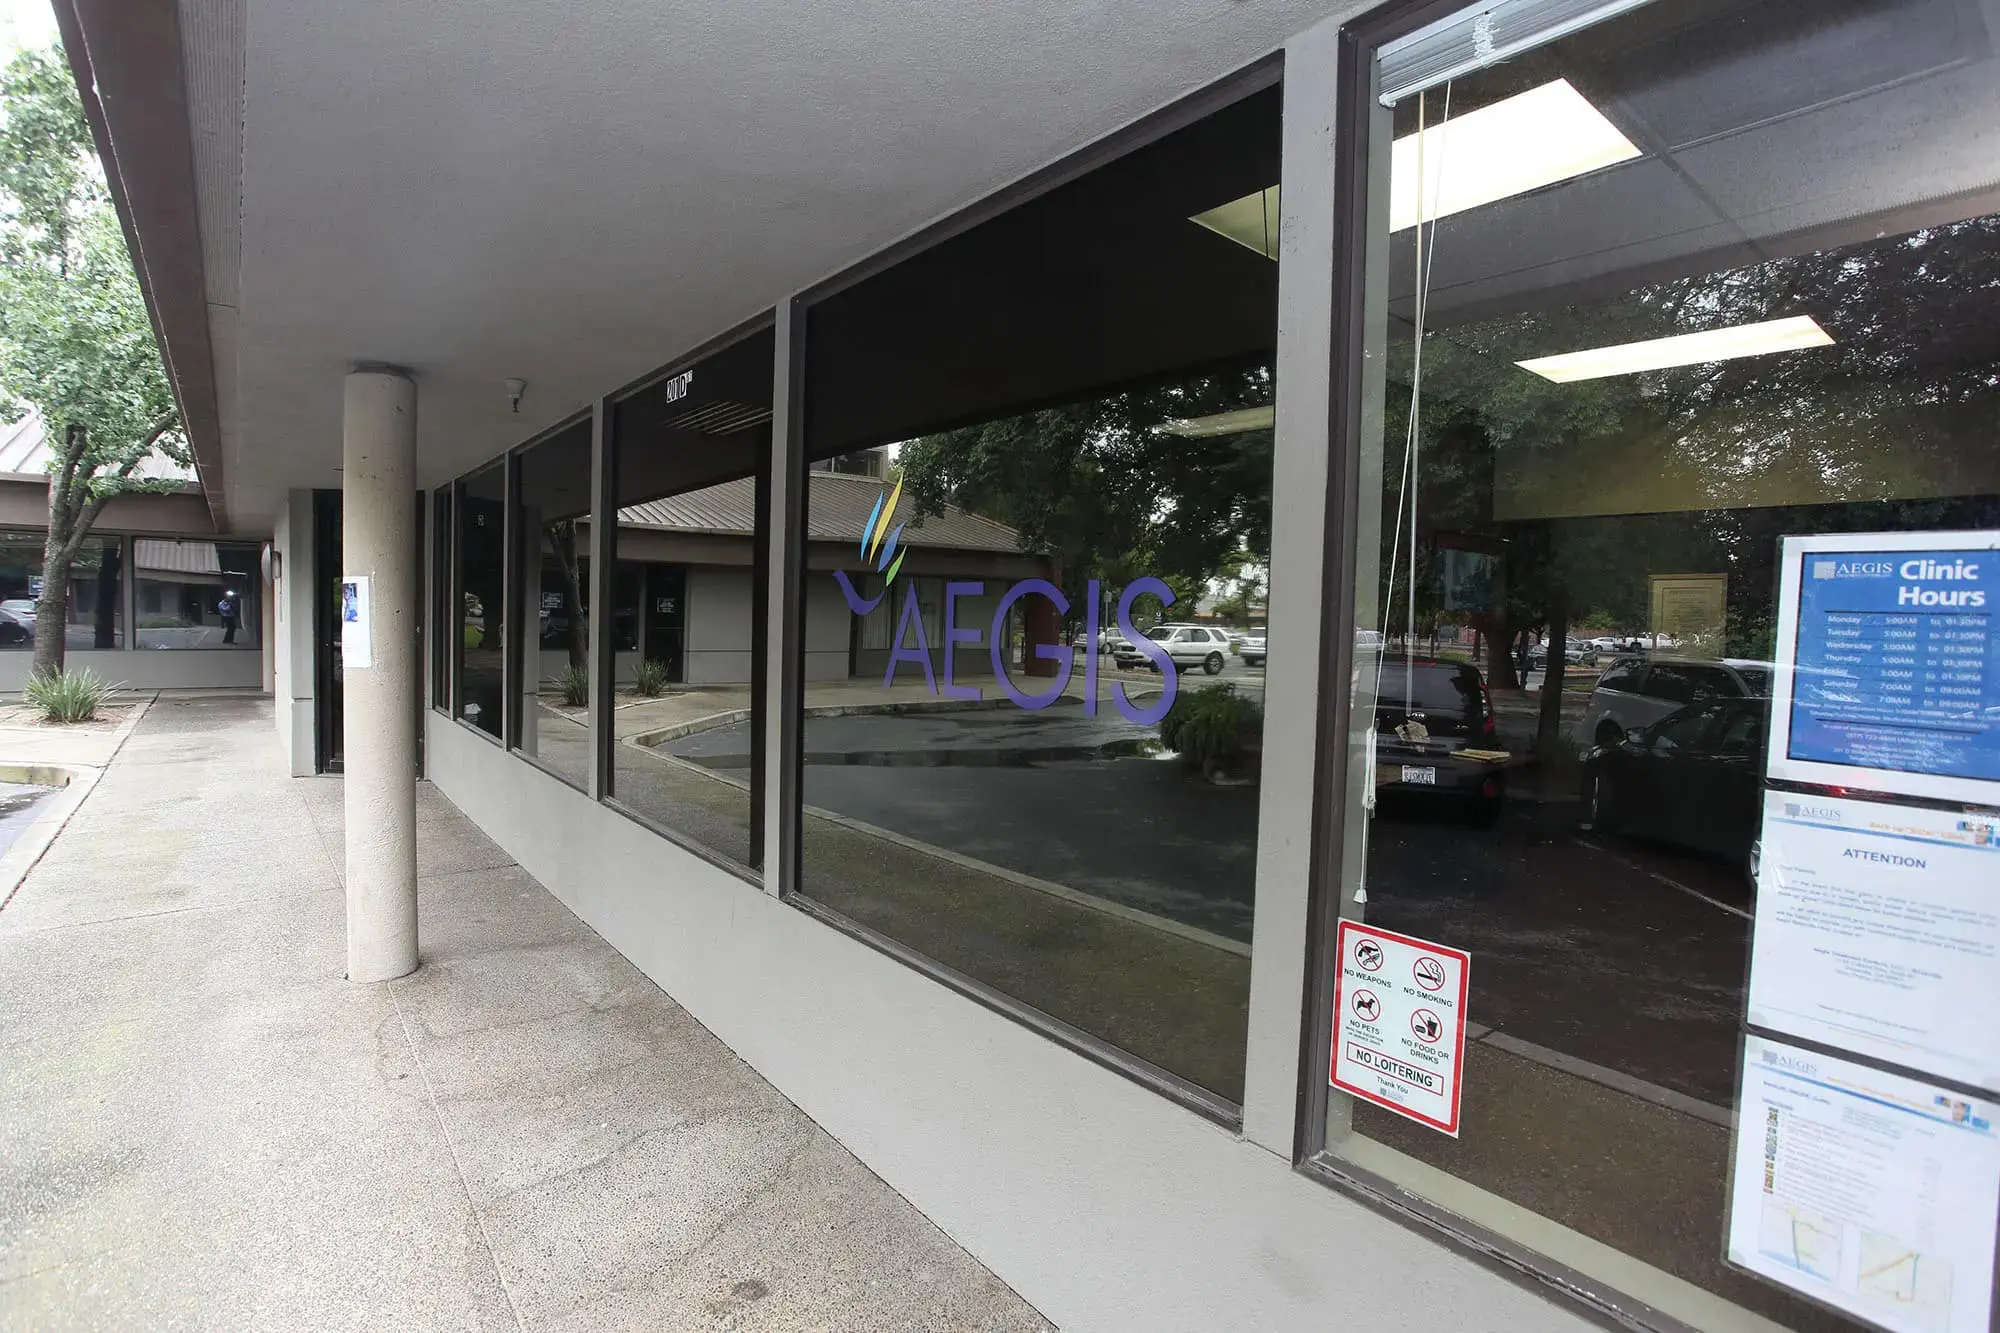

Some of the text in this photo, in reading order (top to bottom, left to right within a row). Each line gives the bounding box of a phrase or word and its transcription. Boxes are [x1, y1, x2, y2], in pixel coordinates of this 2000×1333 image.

[1837, 563, 1893, 574] AEGIS
[1900, 560, 1979, 580] Clinic
[1898, 586, 1985, 607] Hours
[1828, 616, 1861, 624] Monday
[1827, 628, 1861, 637] Tuesday
[883, 576, 1179, 725] AEGIS
[1843, 848, 1926, 869] ATTENTION
[1344, 968, 1392, 988] NO WEAPONS
[1403, 987, 1453, 1008] NO SMOKING
[1350, 1020, 1380, 1035] NO PETS
[1401, 1038, 1450, 1060] NO FOOD OR
[1410, 1049, 1440, 1065] DRINKS
[1356, 1049, 1434, 1087] NO LOITERING
[1376, 1076, 1396, 1089] Thank
